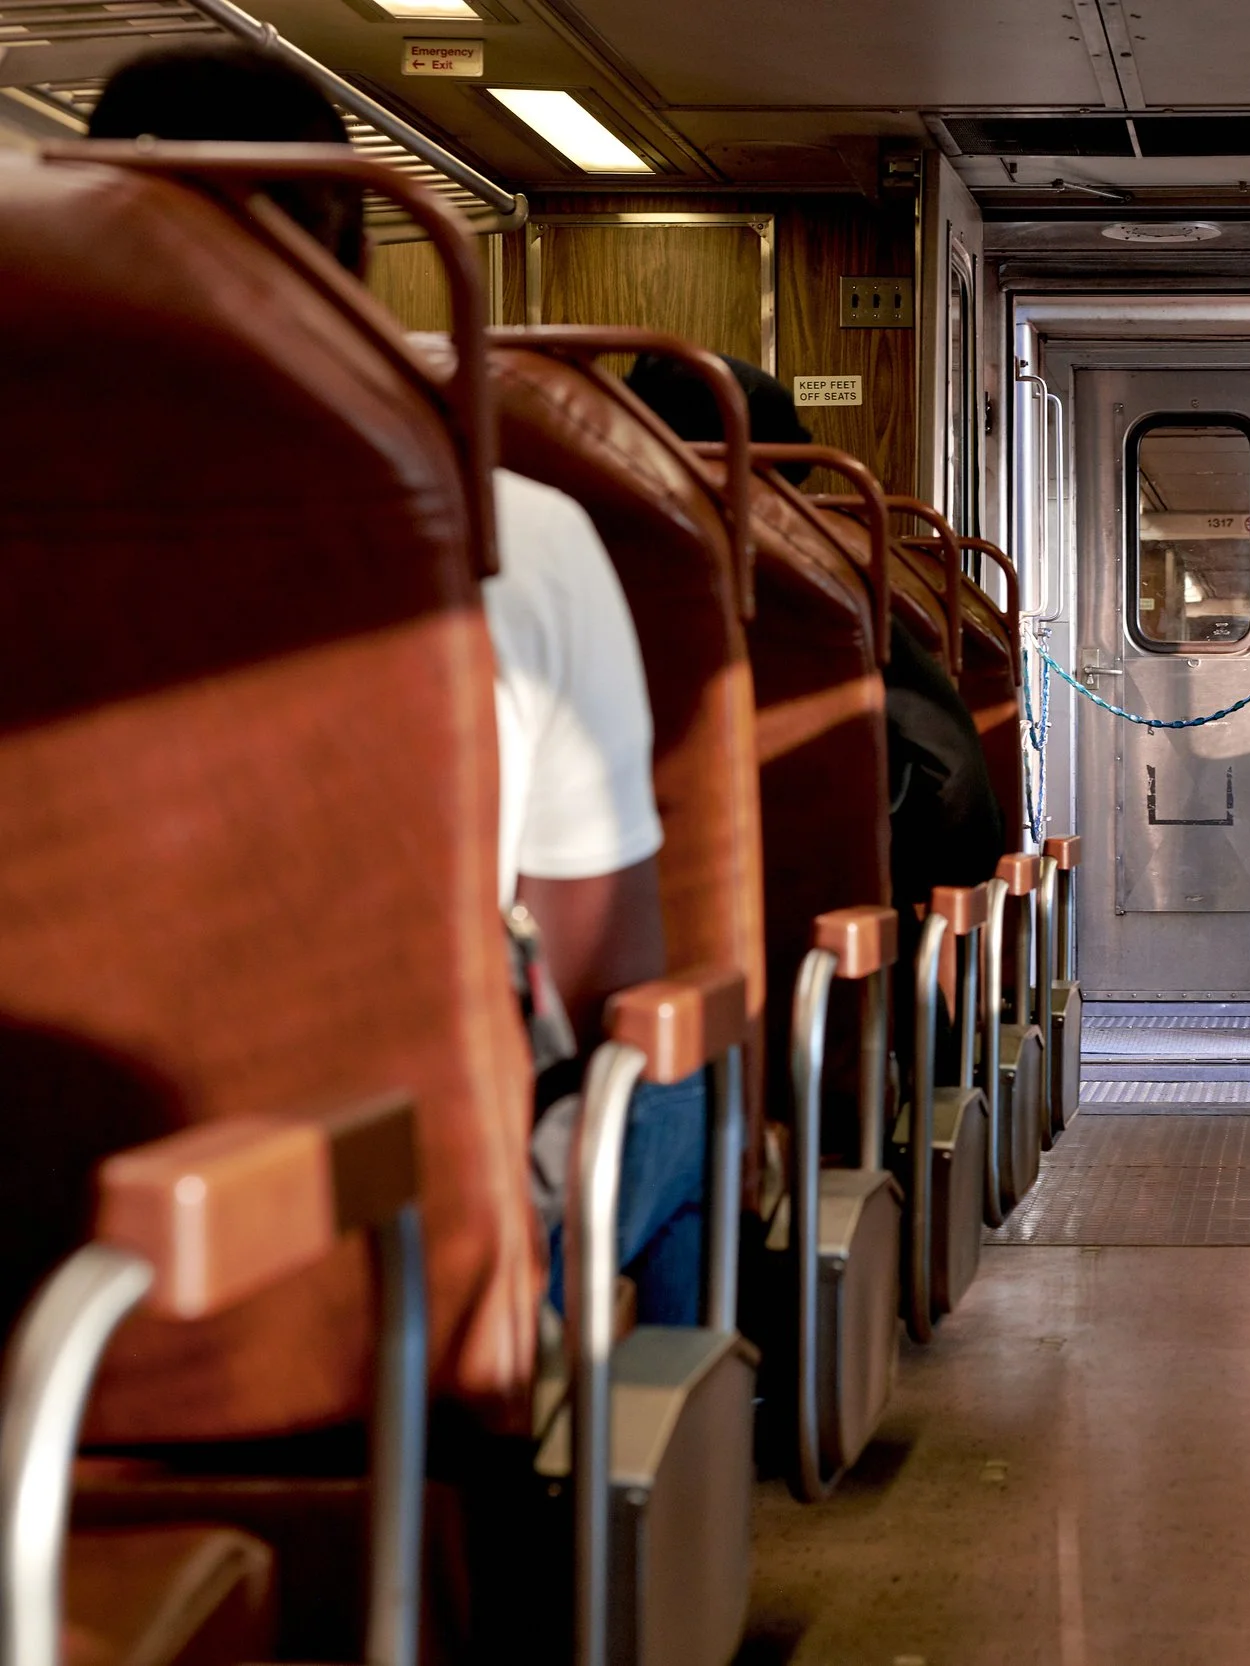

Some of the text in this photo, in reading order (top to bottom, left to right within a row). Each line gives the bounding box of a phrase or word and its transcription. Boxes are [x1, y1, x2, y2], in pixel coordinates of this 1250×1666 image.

[411, 46, 474, 58] Emergency
[432, 60, 453, 70] Exit
[799, 380, 857, 390] KEEP FEET
[799, 392, 857, 401] OFF SEATS
[1207, 518, 1234, 528] 1317
